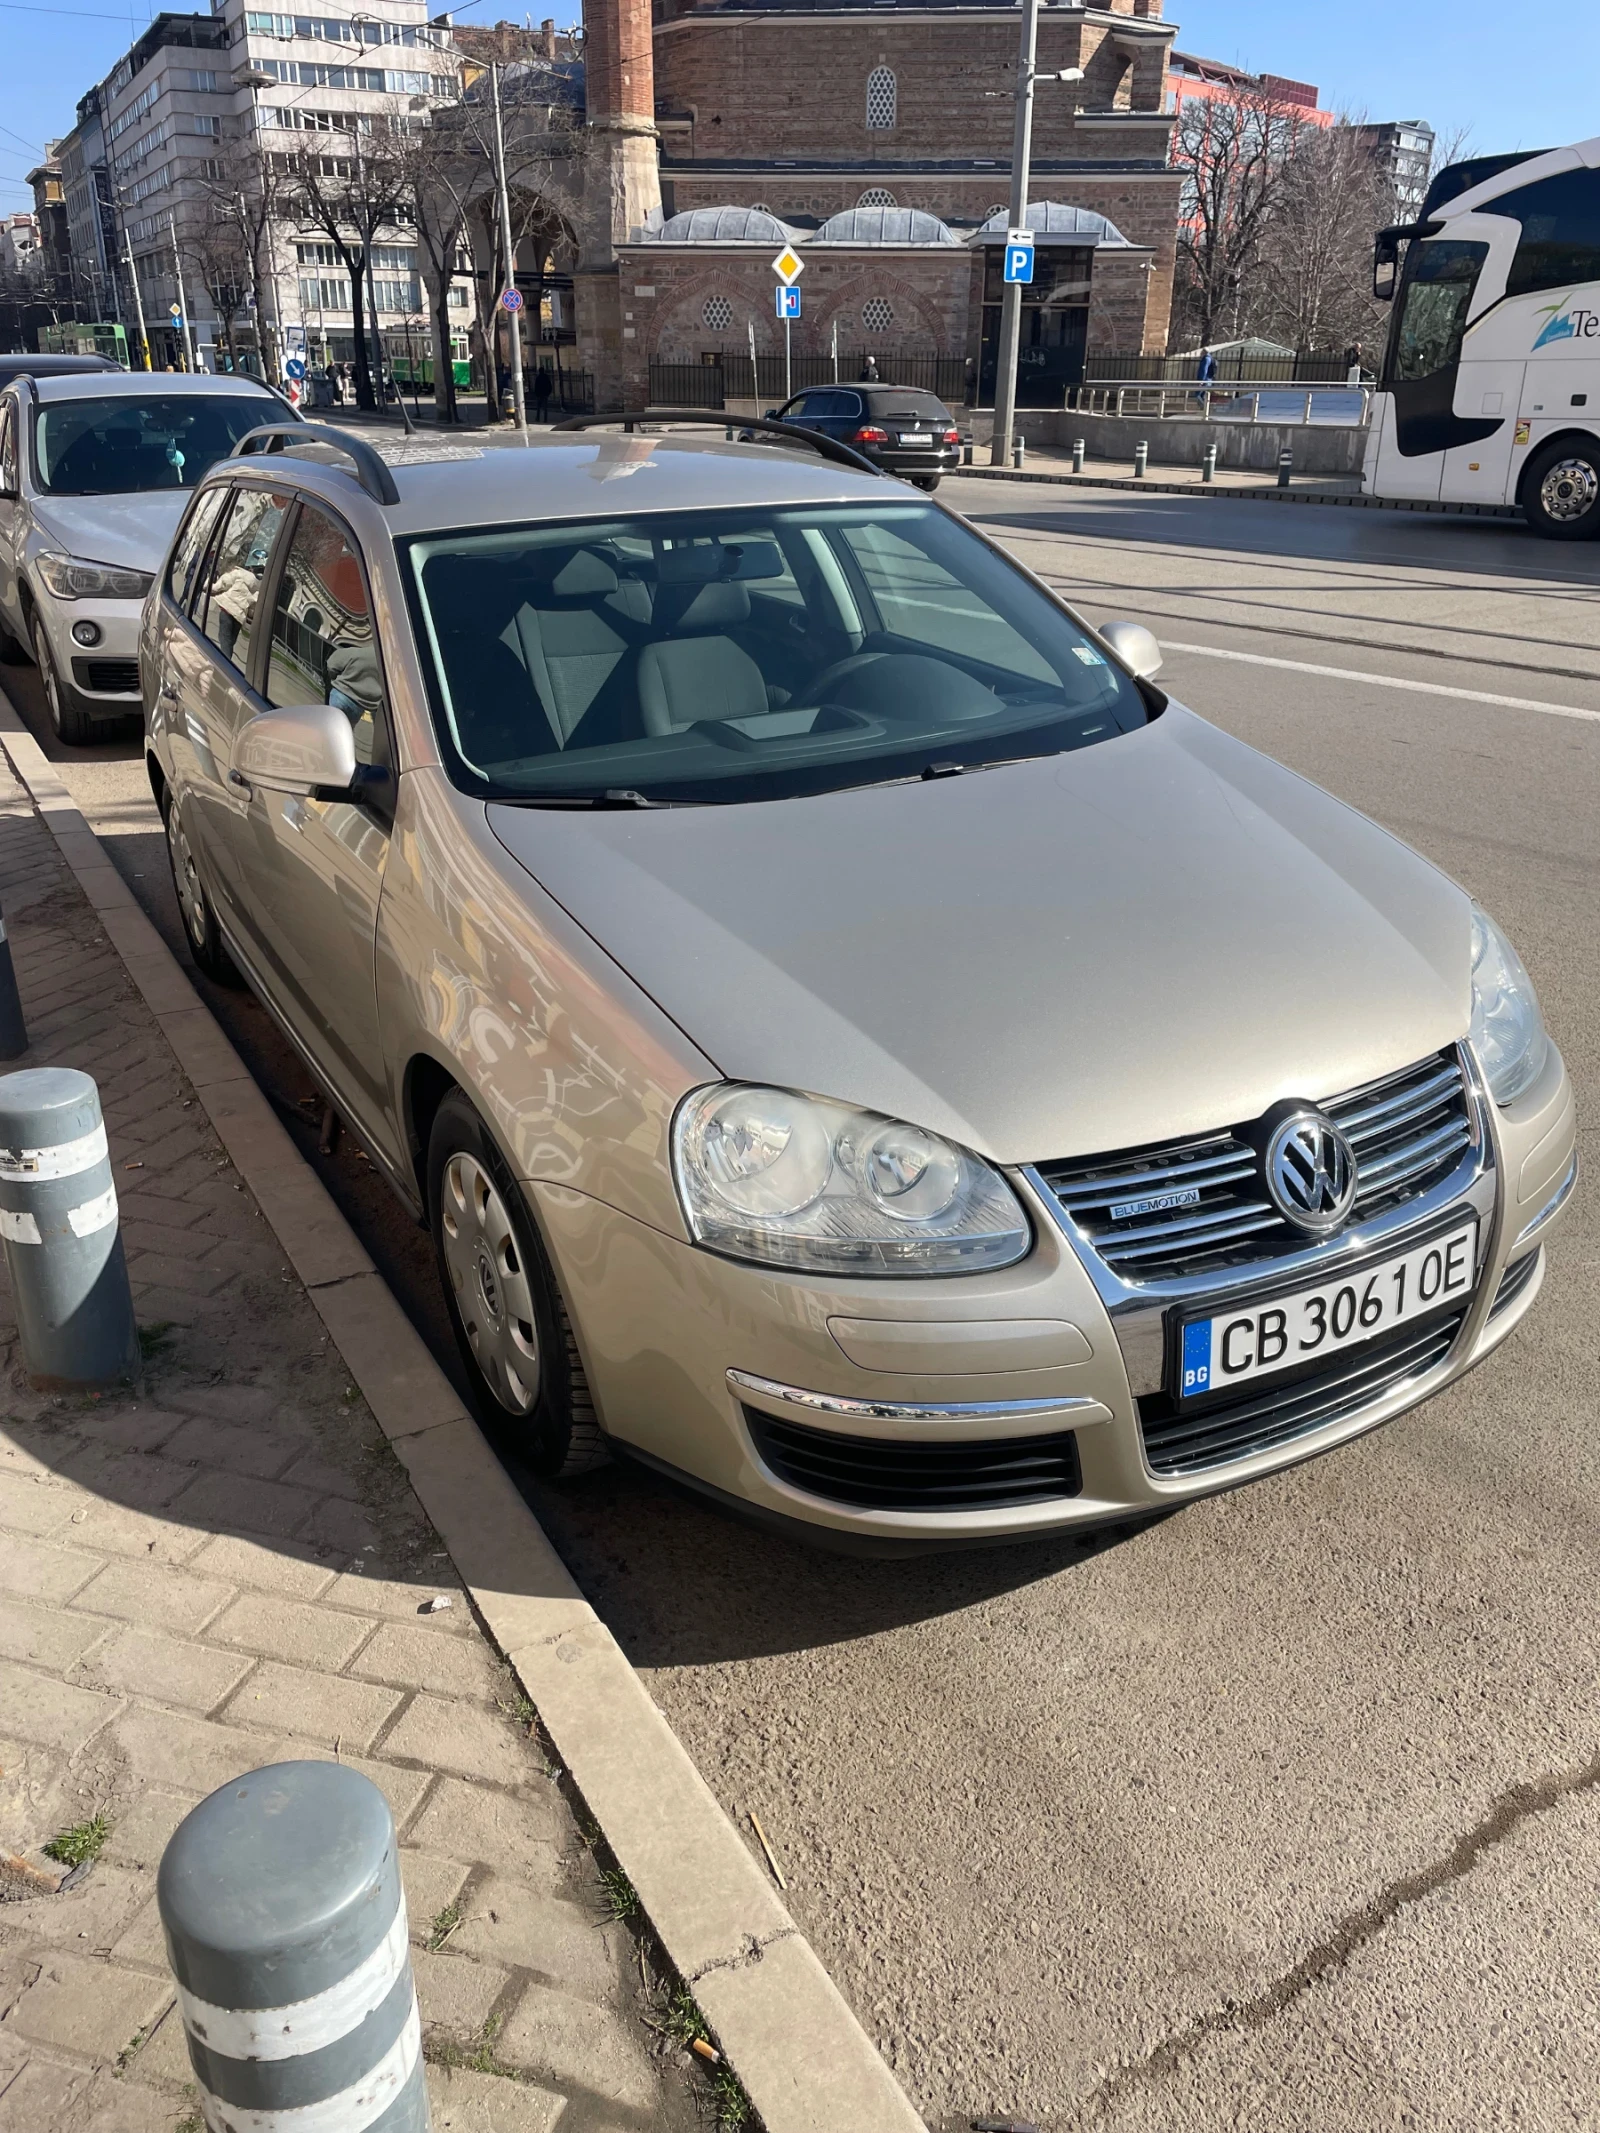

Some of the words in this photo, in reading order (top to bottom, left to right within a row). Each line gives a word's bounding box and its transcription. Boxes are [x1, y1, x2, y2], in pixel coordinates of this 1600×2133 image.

[1011, 250, 1028, 278] P
[1571, 309, 1600, 338] Te
[1113, 1190, 1198, 1218] BLUEMOTION
[1219, 1307, 1288, 1376] CB
[1298, 1262, 1407, 1352] 3061
[1418, 1233, 1469, 1303] OE
[1184, 1365, 1209, 1389] BG
